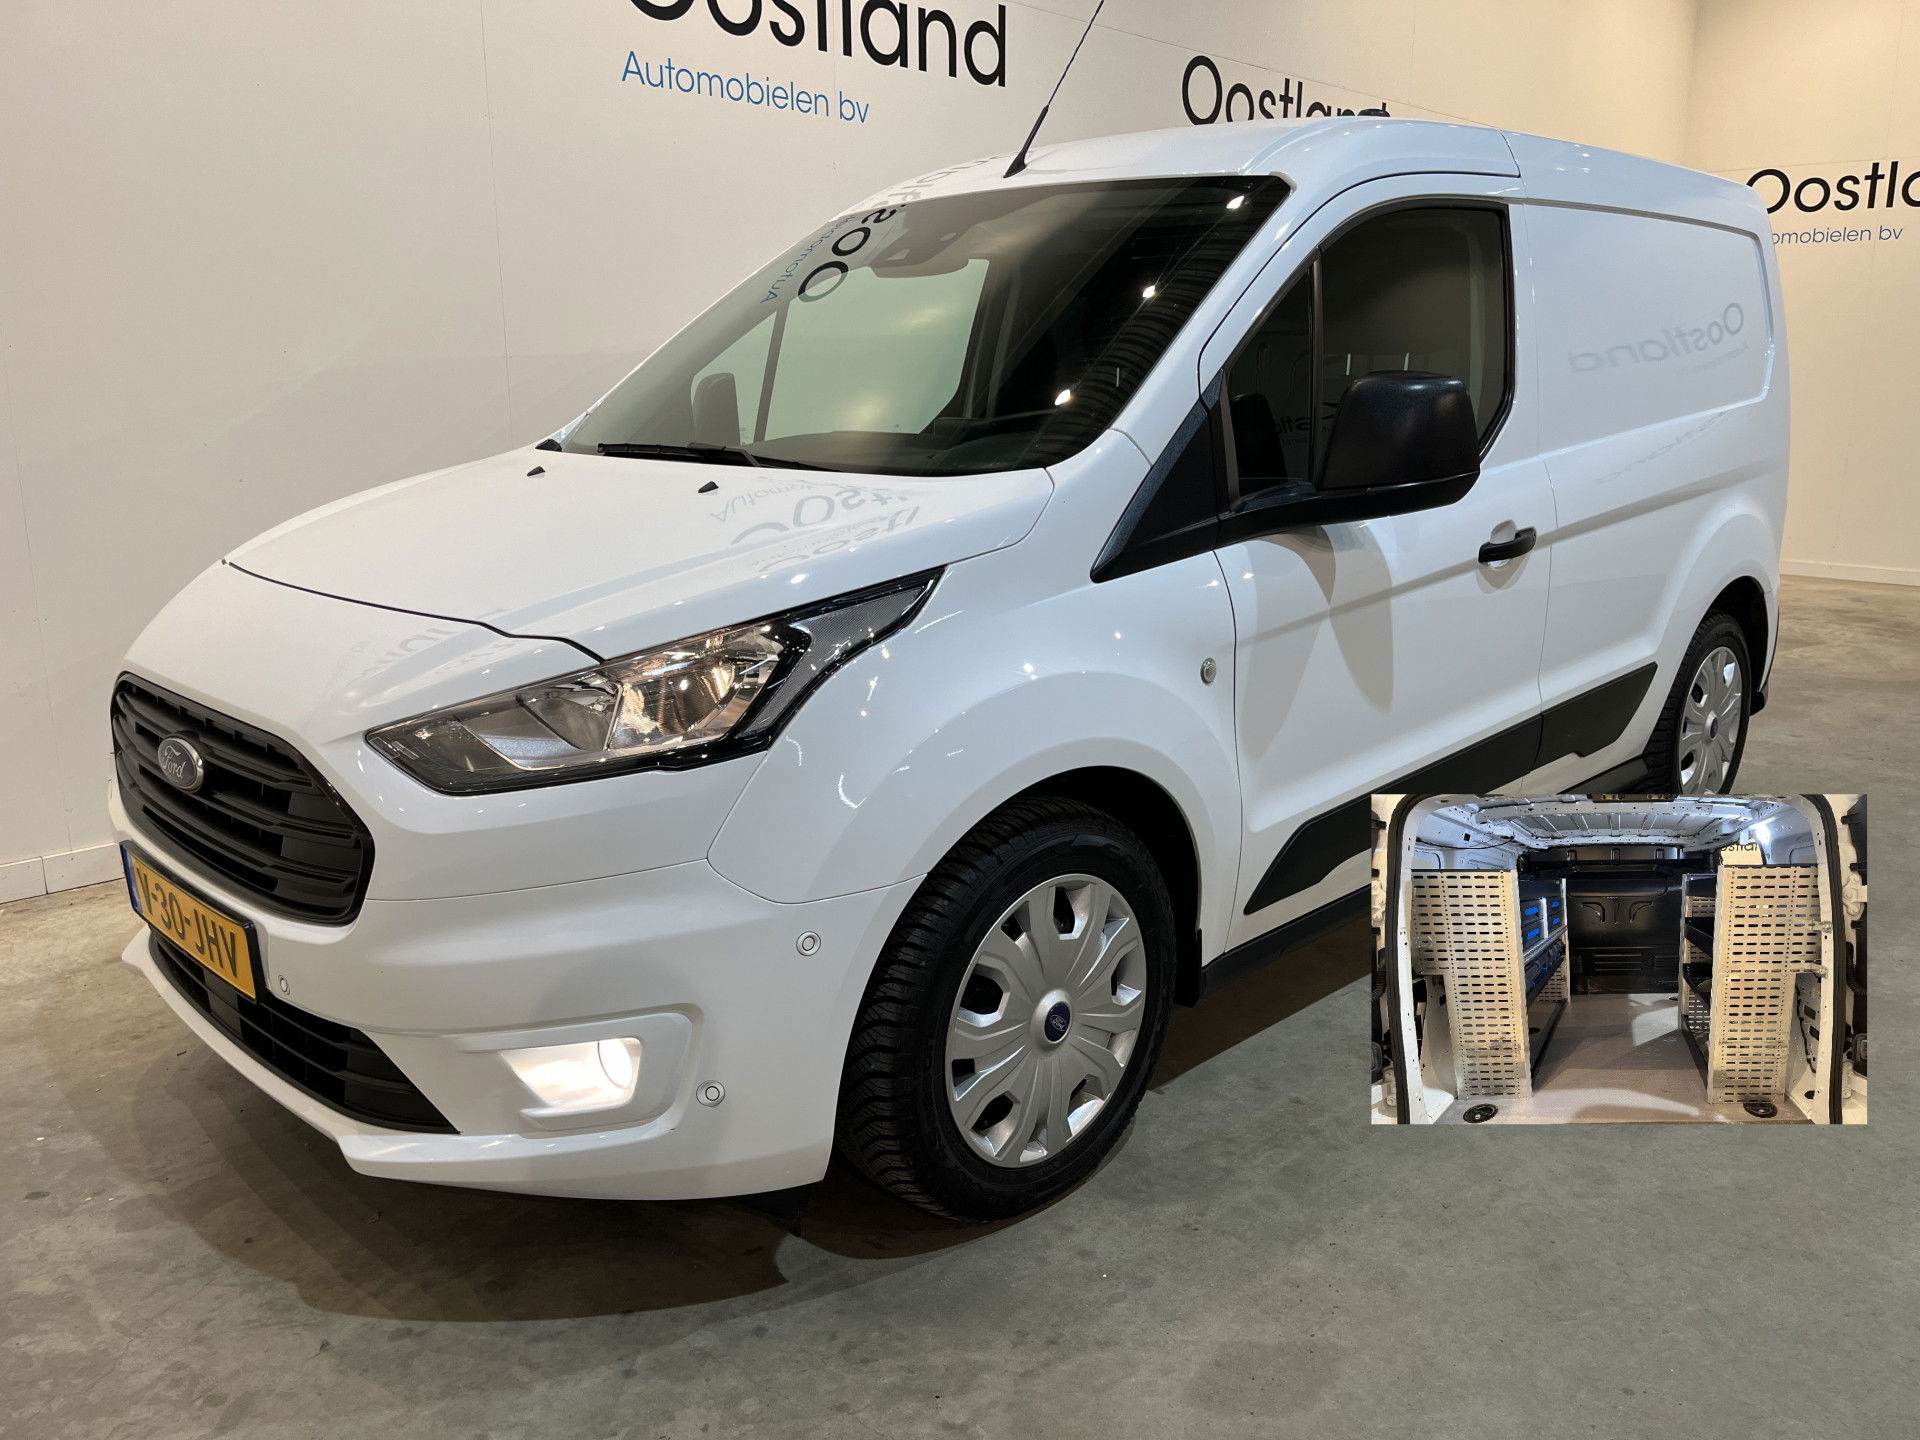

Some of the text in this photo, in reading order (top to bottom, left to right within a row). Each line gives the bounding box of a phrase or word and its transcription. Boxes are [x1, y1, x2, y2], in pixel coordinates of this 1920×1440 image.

[630, 0, 1006, 87] ostland
[621, 51, 869, 123] Automobielen bv
[1878, 225, 1903, 241] bv
[162, 745, 187, 779] Ford
[135, 866, 238, 980] V-30-JHV
